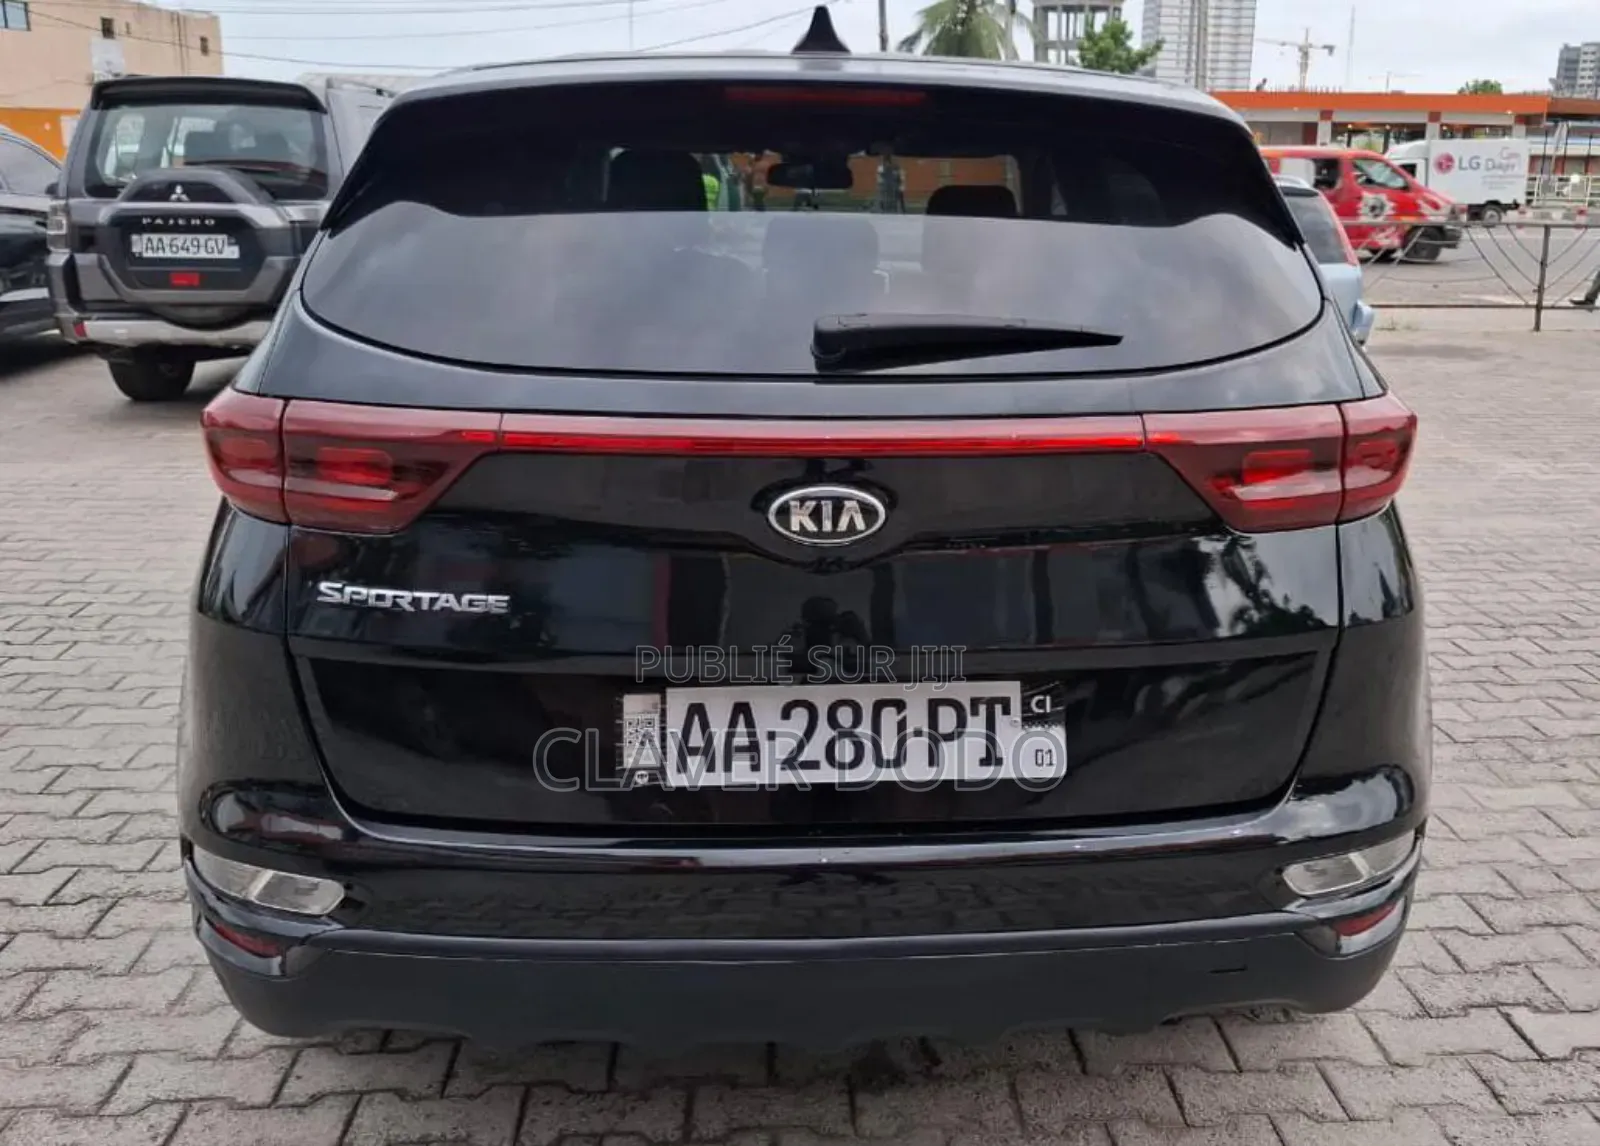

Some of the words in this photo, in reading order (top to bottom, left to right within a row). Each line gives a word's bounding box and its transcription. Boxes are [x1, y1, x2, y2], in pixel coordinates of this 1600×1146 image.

[1458, 154, 1481, 171] LG
[142, 217, 216, 226] PAJERO
[788, 499, 867, 533] KIA
[316, 580, 511, 615] SPORTAGE
[1030, 694, 1052, 714] CI
[1034, 748, 1055, 768] 01
